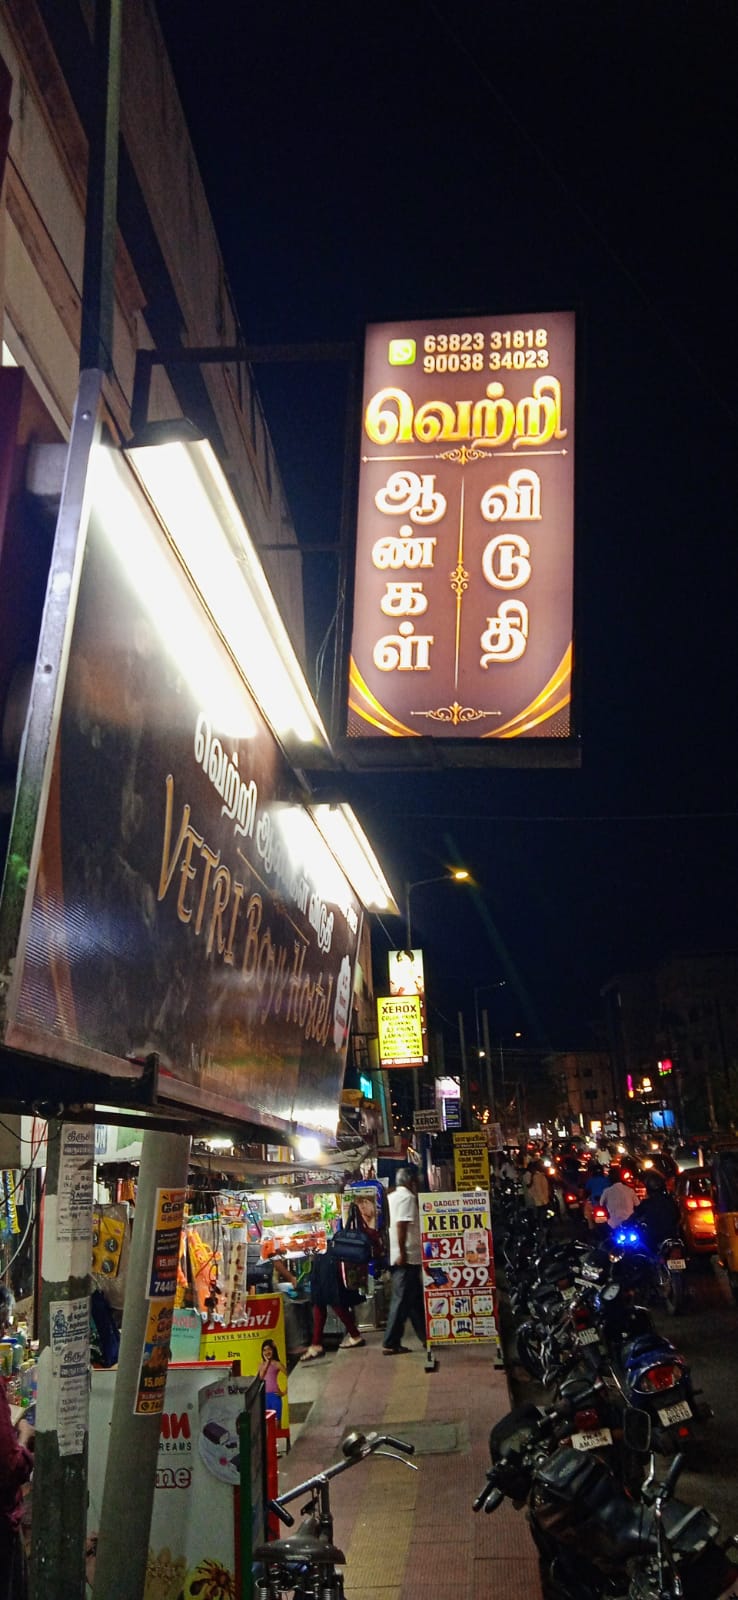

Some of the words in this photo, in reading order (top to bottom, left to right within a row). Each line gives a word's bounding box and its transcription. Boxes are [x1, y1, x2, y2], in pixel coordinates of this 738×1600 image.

[424, 332, 485, 353] 63823
[490, 328, 548, 349] 31818
[423, 352, 484, 374] 90038
[489, 349, 549, 370] 34023
[365, 375, 567, 450] வெற்றி
[372, 470, 447, 672] ஆண்கள்
[479, 468, 542, 670] விடுதி
[194, 711, 258, 839] வெற்றி
[157, 774, 245, 966] VETRI
[382, 1004, 417, 1015] XEROX
[433, 1199, 460, 1207] GADGET
[462, 1197, 487, 1206] WORLD
[427, 1213, 484, 1231] XEROX
[450, 1266, 489, 1288] 999
[227, 1350, 241, 1359] Bra
